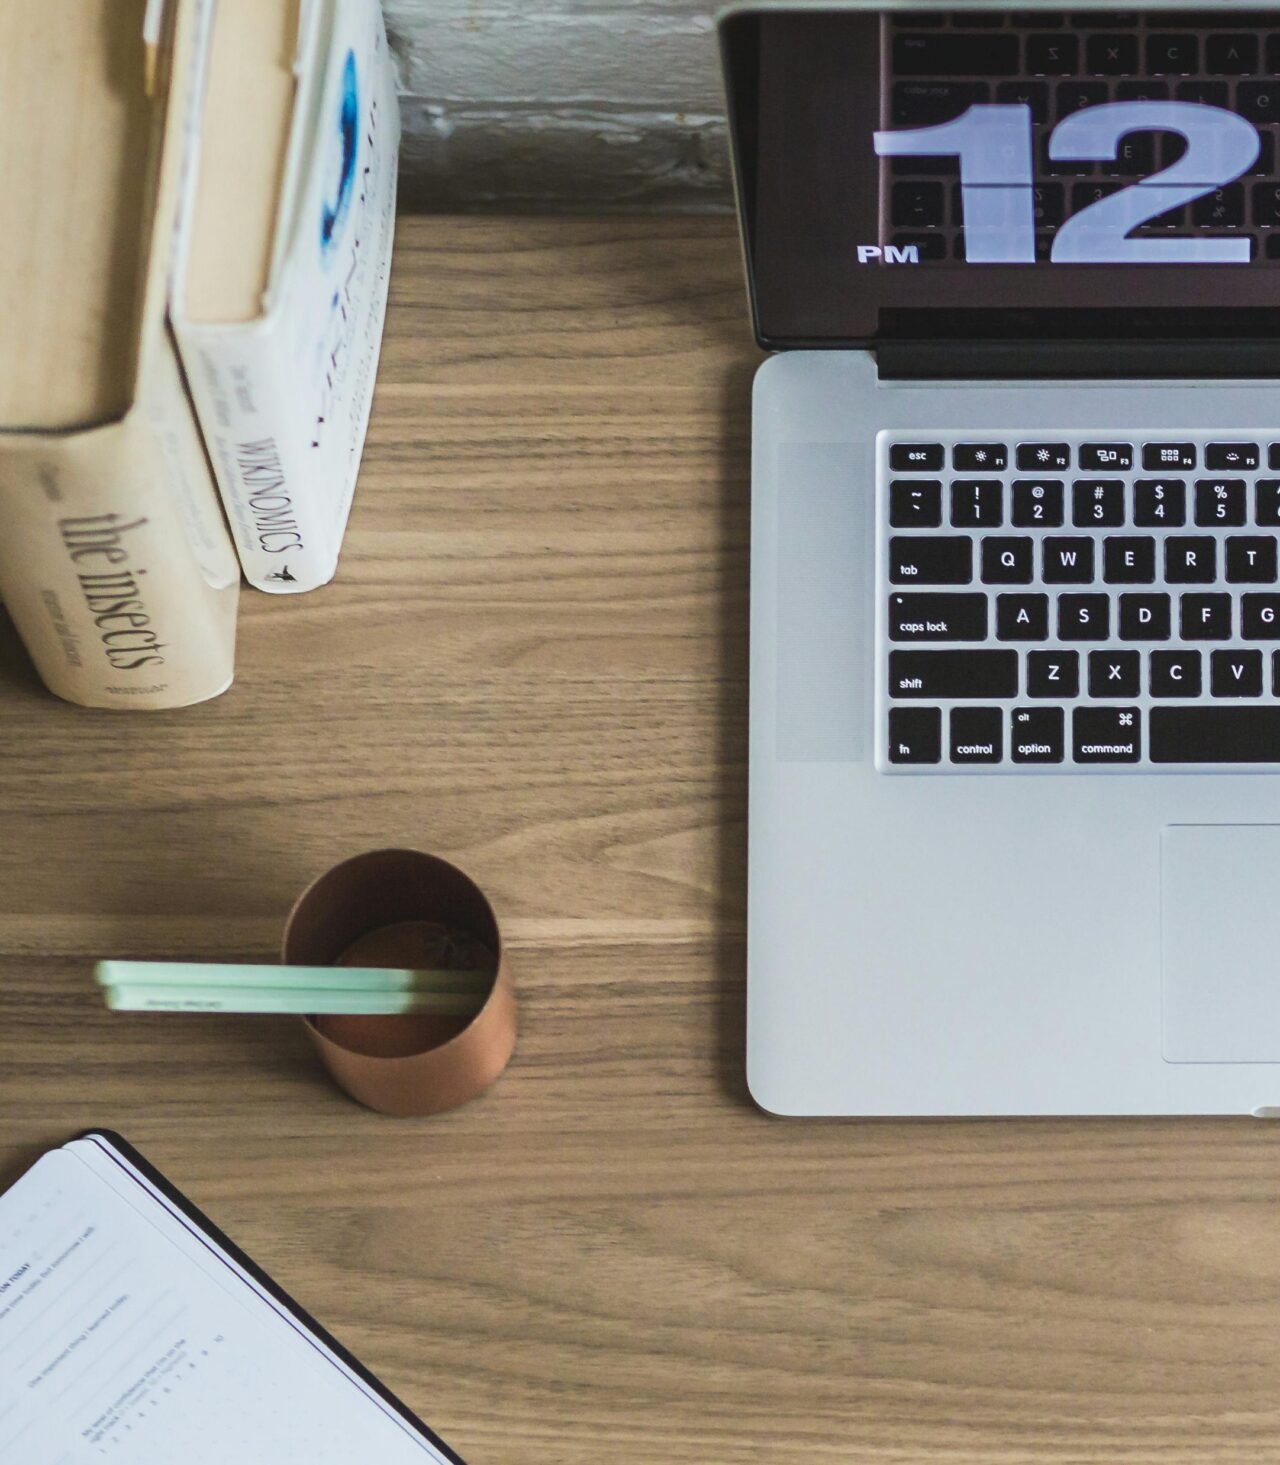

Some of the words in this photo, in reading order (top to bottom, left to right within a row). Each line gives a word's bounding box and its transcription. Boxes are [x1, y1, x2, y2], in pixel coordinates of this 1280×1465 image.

[875, 103, 1260, 263] 12
[857, 245, 919, 263] PM
[908, 452, 927, 460] esc
[1056, 457, 1066, 465] F2
[1246, 457, 1256, 465] F5
[235, 437, 304, 553] WIKINOMICS
[975, 486, 980, 500] !
[1031, 486, 1045, 499] @
[1093, 486, 1105, 500] #
[1154, 484, 1164, 500] $
[1213, 485, 1228, 499] %
[973, 504, 980, 519] 1
[1033, 504, 1043, 519] 2
[1093, 504, 1104, 519] 3
[1154, 503, 1165, 518] 4
[1216, 503, 1226, 518] 5
[57, 512, 149, 565] the
[900, 564, 918, 575] tab
[1000, 551, 1015, 567] Q
[1060, 551, 1077, 567] W
[1125, 551, 1135, 566] E
[1185, 551, 1197, 567] R
[1246, 550, 1257, 566] T
[78, 568, 169, 670] insects
[899, 623, 925, 634] caps
[926, 621, 948, 632] lock
[1016, 608, 1030, 624] A
[1079, 608, 1090, 623] S
[1139, 607, 1152, 623] D
[1201, 607, 1211, 623] F
[1260, 607, 1275, 623] G
[899, 678, 923, 689] shift
[1048, 665, 1060, 681] Z
[1108, 664, 1122, 680] X
[1169, 664, 1183, 680] C
[1231, 664, 1244, 680] V
[1017, 713, 1030, 722] alt
[898, 743, 910, 755] fn
[956, 743, 993, 755] control
[1017, 743, 1051, 756] option
[1081, 743, 1133, 754] command
